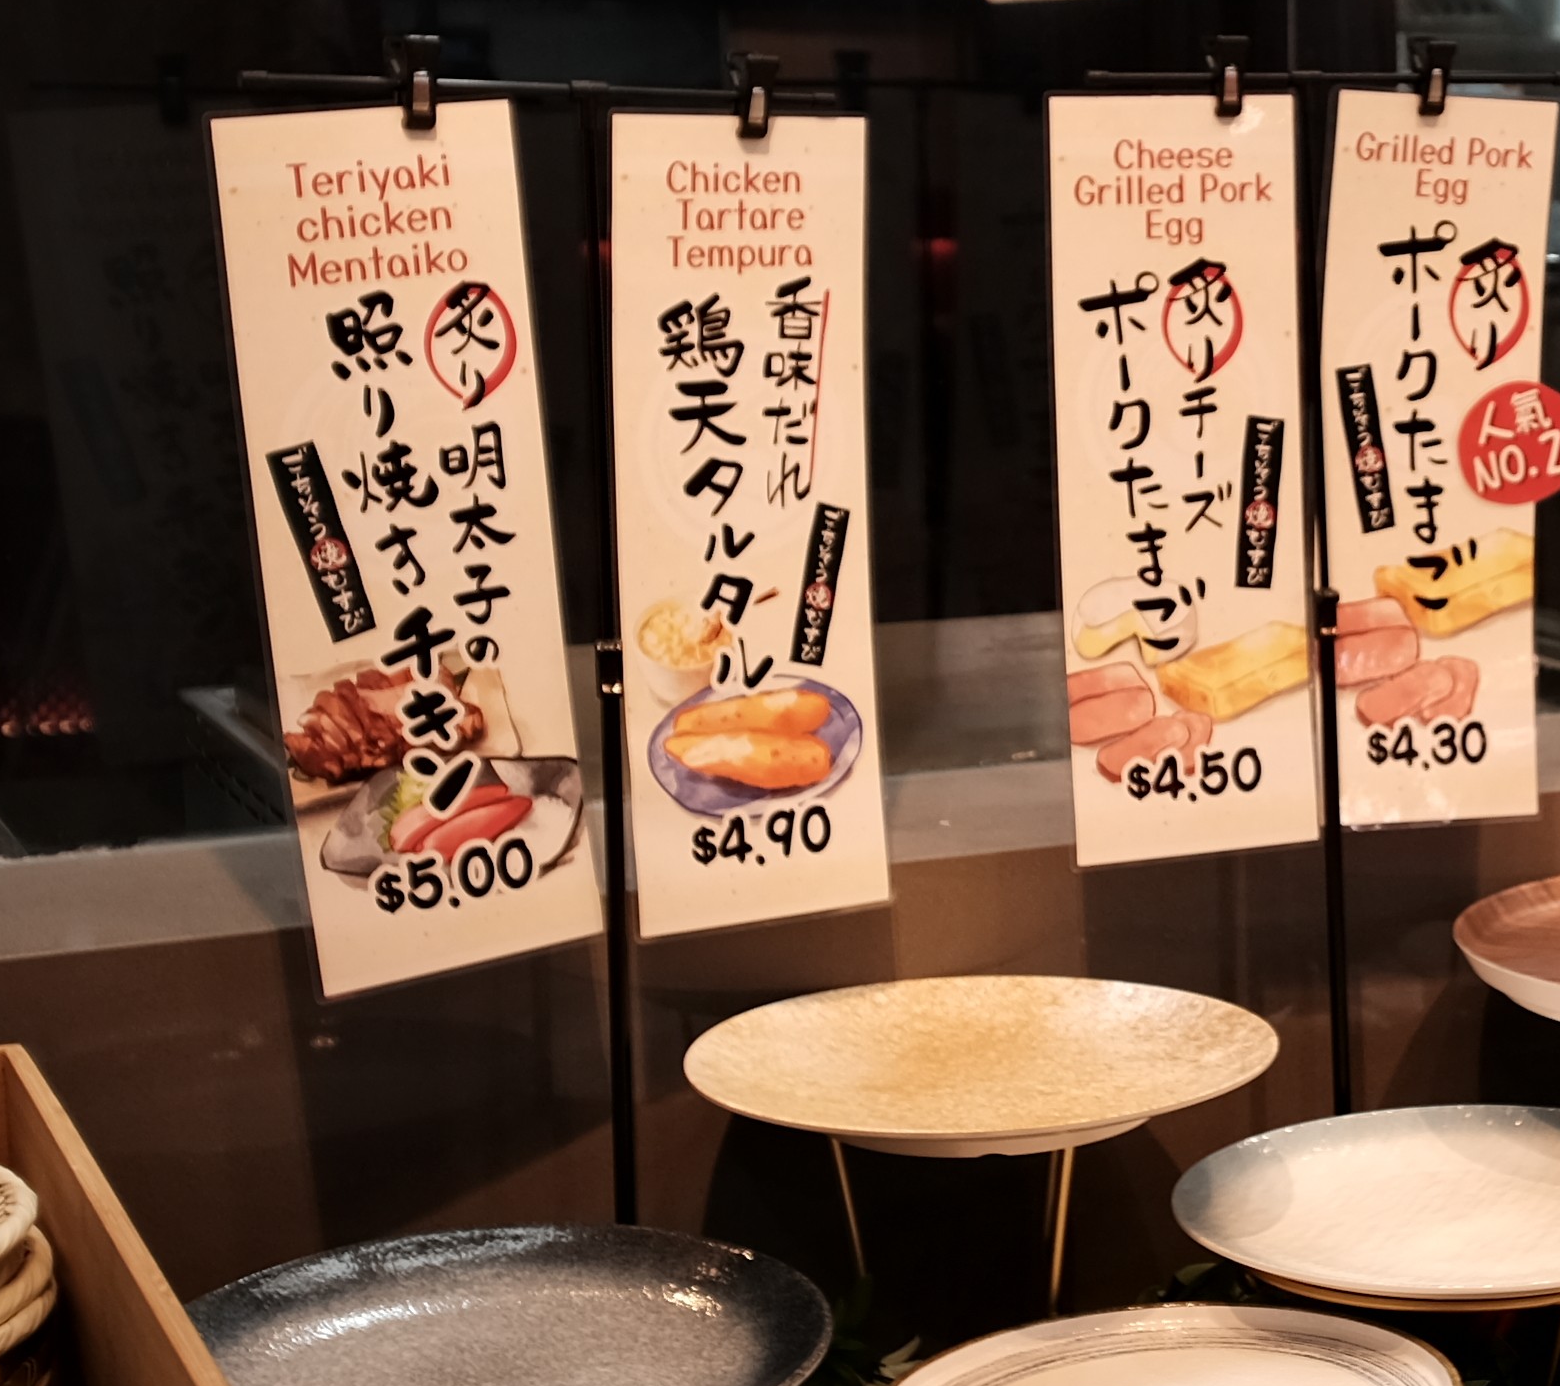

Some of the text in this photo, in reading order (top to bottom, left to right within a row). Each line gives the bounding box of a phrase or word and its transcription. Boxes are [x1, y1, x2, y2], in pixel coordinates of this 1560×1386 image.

[1114, 140, 1233, 171] Cheese
[1356, 133, 1533, 169] Grilled Pork
[286, 154, 450, 200] Teriyaki
[666, 160, 801, 194] Chicken
[1074, 173, 1273, 207] Grilled Pork
[1415, 169, 1468, 204] Egg
[297, 202, 452, 243] chicken
[678, 198, 805, 231] Tartare
[1145, 210, 1204, 245] Egg
[287, 242, 468, 288] Mentaiko
[667, 236, 813, 273] Tempura
[1460, 238, 1520, 370] 炙り
[762, 276, 822, 508] 香味だれ
[1379, 220, 1477, 611] ポークたまご
[1477, 387, 1551, 443] 人氣
[1080, 270, 1206, 651] ポークたまご
[658, 293, 774, 689] 鶏天タルタル
[325, 289, 484, 810] 照り焼きチキン
[1367, 721, 1487, 770] $4.30
[1126, 748, 1262, 801] $4.50
[692, 806, 833, 865] $4.90
[374, 840, 535, 913] $5.00
